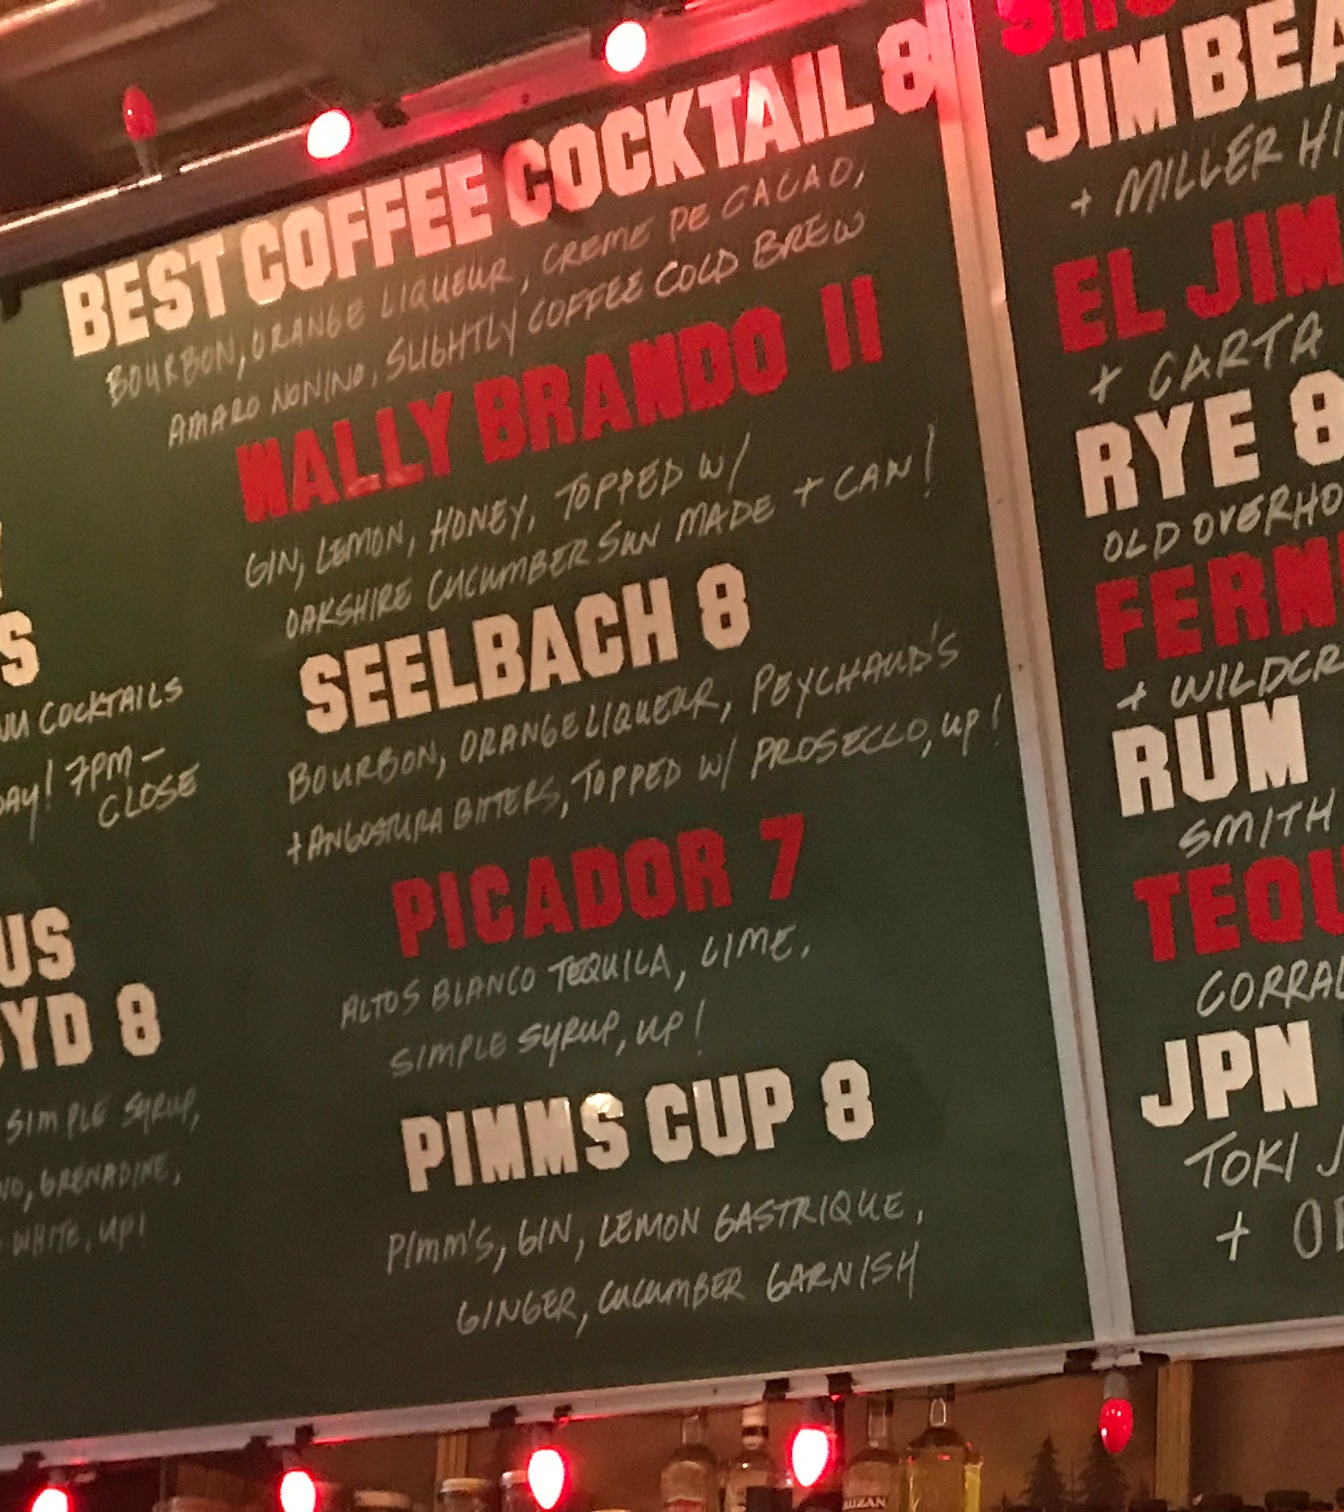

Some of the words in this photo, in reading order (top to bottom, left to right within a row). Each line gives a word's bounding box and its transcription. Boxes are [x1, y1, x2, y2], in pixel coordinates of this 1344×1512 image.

[1026, 33, 1177, 164] JIM
[62, 234, 229, 357] BEST
[239, 154, 492, 306] COFFEE
[503, 42, 875, 228] COCKTAIL
[877, 19, 935, 116] 8
[1114, 121, 1284, 220] MILLER
[528, 271, 646, 338] COFFEE
[655, 249, 743, 299] COLD
[752, 209, 867, 271] BREW
[543, 220, 651, 275] CREME
[1054, 246, 1167, 355] EL
[1147, 308, 1324, 404] CARTA
[236, 389, 456, 524] WALLY
[472, 304, 790, 467] BRANDO
[1074, 386, 1259, 519] RYE
[429, 492, 538, 549] HONEY,
[553, 455, 684, 520] TOPPED
[1102, 521, 1184, 565] OLD
[285, 577, 414, 640] OAKSHIRE
[426, 536, 592, 604] CUCUMBER
[675, 493, 775, 545] MADE
[299, 575, 680, 735] SEELBACH
[696, 562, 751, 649] 8
[39, 676, 183, 735] COCKTAILS
[285, 739, 449, 805] BOURBON,
[458, 703, 578, 768] ORANGE
[98, 763, 199, 829] CLOSE
[571, 749, 682, 805] TOPPED
[1111, 693, 1310, 819] RUM
[1178, 788, 1337, 859] SMITH
[391, 827, 733, 960] PICADOR
[760, 812, 805, 901] 7
[116, 982, 162, 1058] 8
[339, 978, 421, 1031] ALTOS
[431, 965, 537, 1012] BLANCO
[547, 942, 688, 997] TEQUILA,
[389, 1029, 508, 1079] SIMPLE
[1139, 1019, 1319, 1131] JPN
[400, 1090, 632, 1195] PIMMS
[645, 1065, 796, 1165] CUP
[820, 1057, 875, 1143] 8
[1184, 1127, 1300, 1192] TOKI
[596, 1204, 702, 1249] LEMON
[712, 1185, 926, 1245] GASTRIQUE,
[456, 1282, 590, 1340] GINGER,
[596, 1264, 748, 1317] CUCUMBER
[765, 1238, 923, 1305] GARNISH
